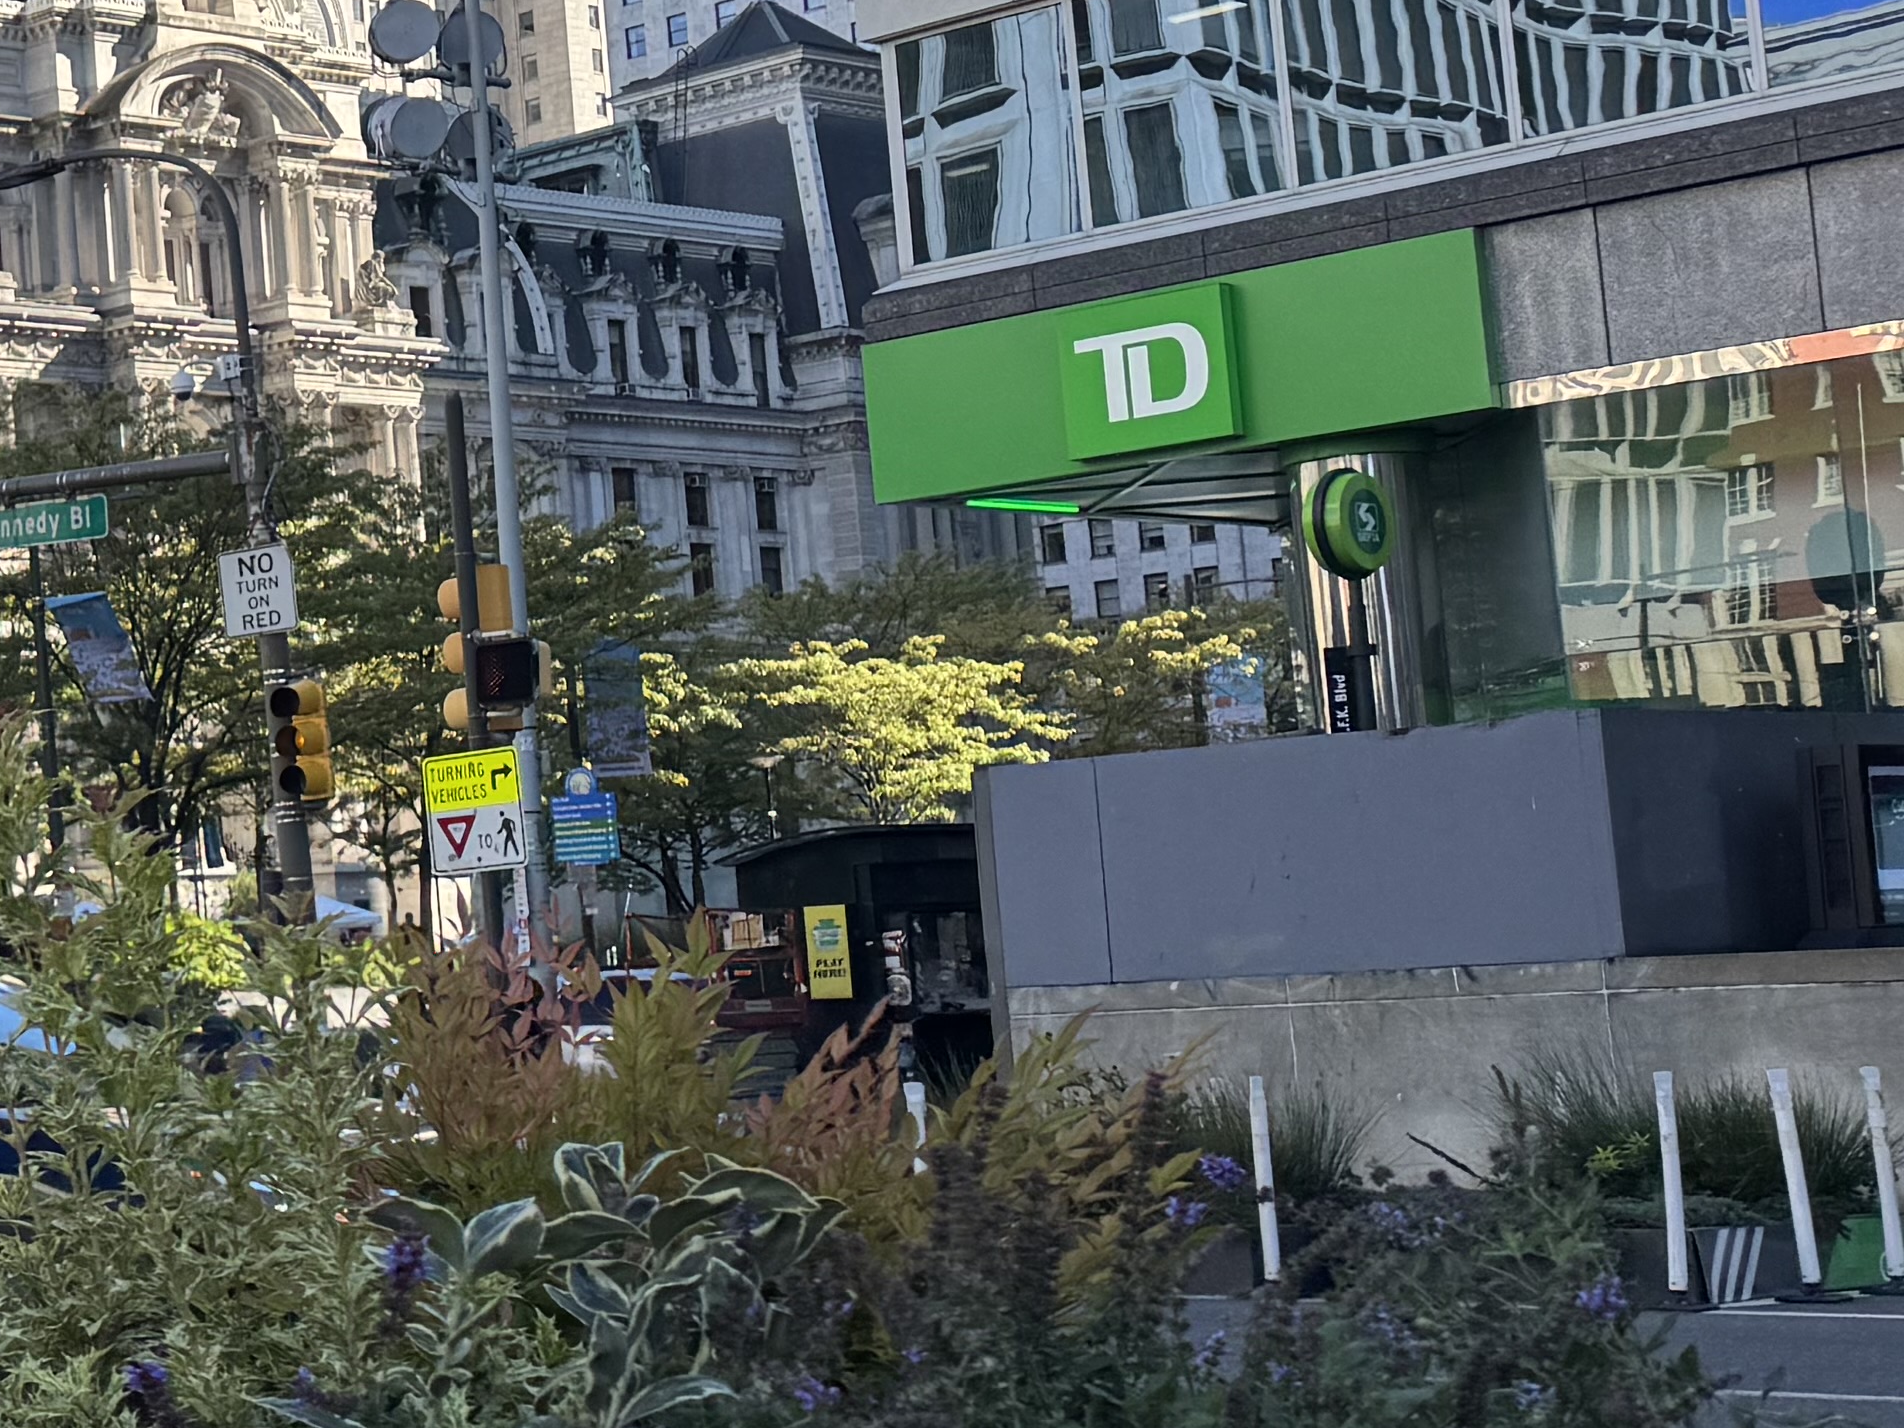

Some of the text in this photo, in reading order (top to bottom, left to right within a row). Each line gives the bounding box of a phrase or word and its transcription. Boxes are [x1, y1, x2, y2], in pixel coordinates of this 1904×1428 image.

[1074, 322, 1209, 422] TD
[238, 553, 273, 577] NO
[236, 575, 278, 594] TURN
[248, 594, 269, 609] ON
[242, 610, 281, 630] RED
[1332, 674, 1348, 702] Blvd
[430, 762, 485, 783] TURNING
[431, 783, 487, 804] VEHICLES
[478, 833, 493, 849] TO
